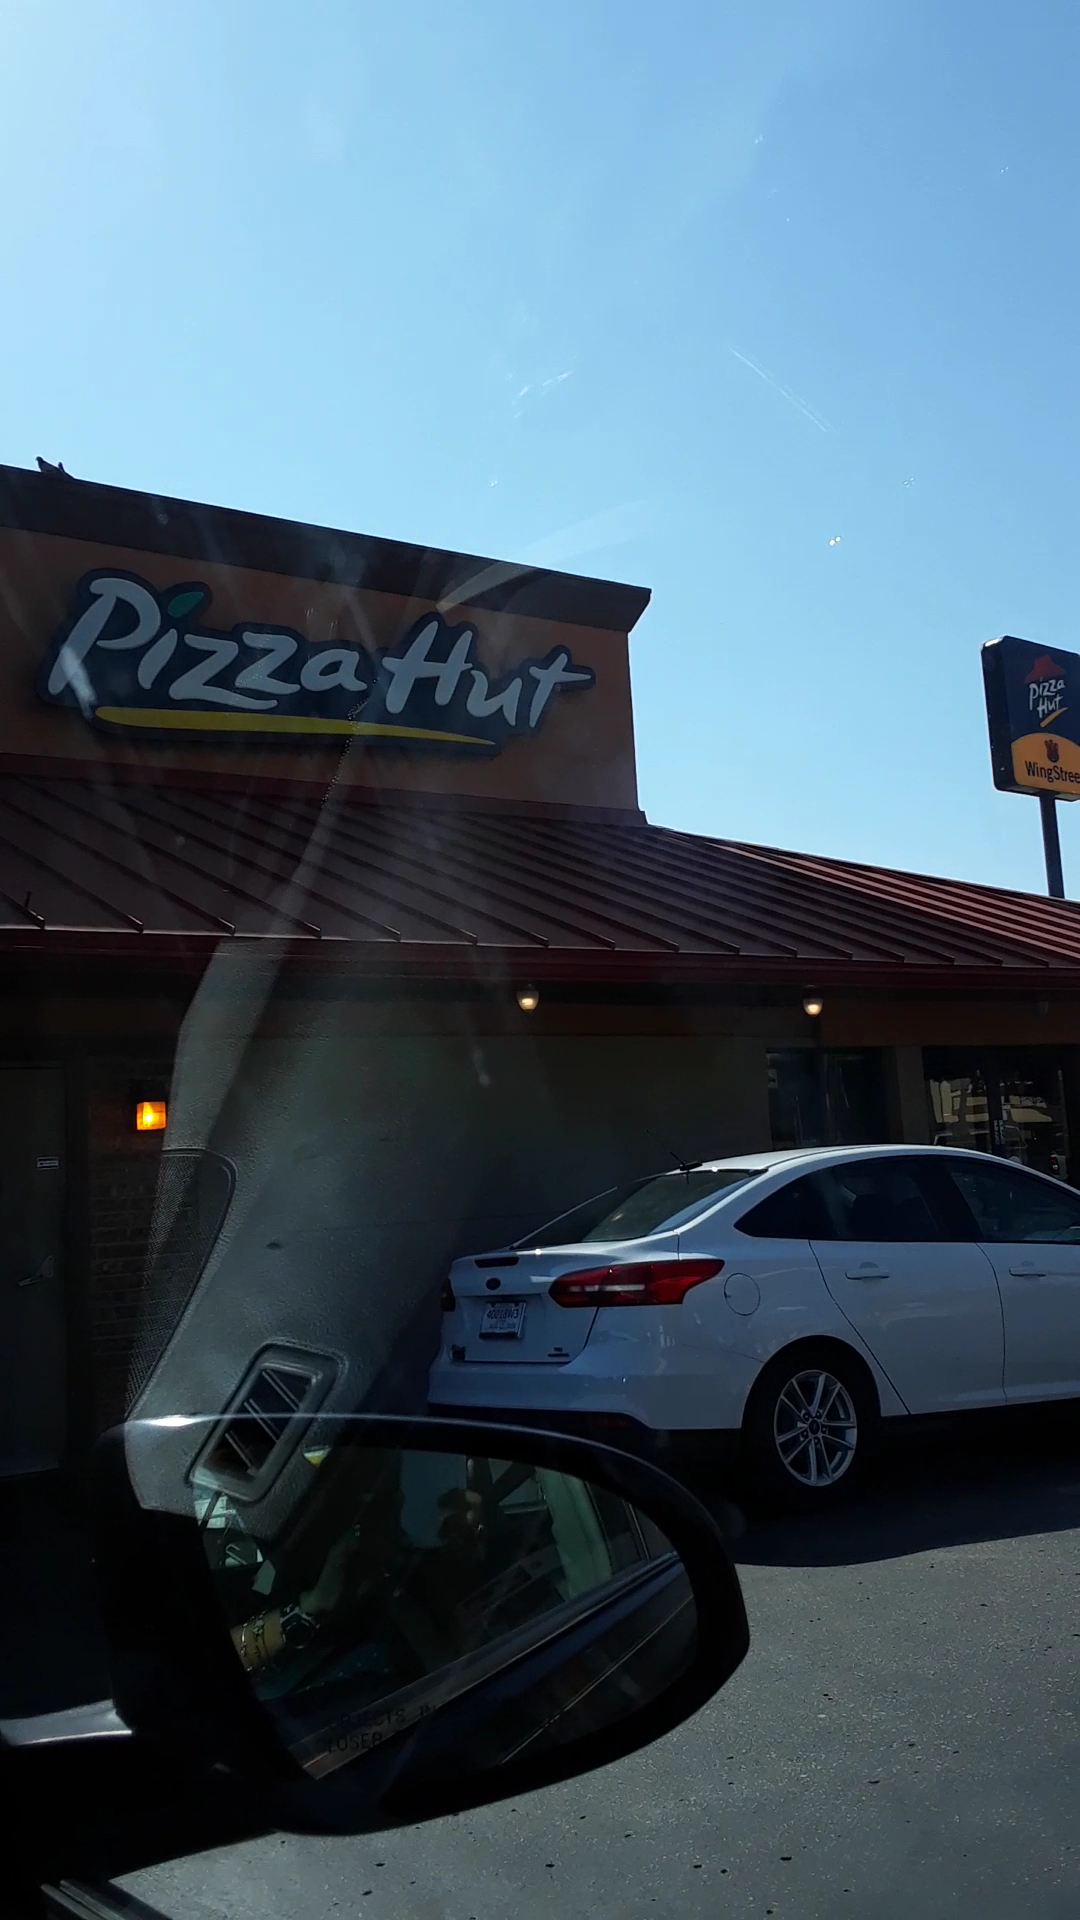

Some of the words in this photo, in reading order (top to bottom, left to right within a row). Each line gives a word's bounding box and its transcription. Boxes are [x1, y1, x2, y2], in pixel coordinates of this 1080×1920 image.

[48, 577, 367, 711] Pizza
[382, 621, 592, 728] Hut
[1028, 676, 1066, 711] Pizza
[1036, 695, 1064, 719] Hut
[1024, 760, 1080, 784] WingStree
